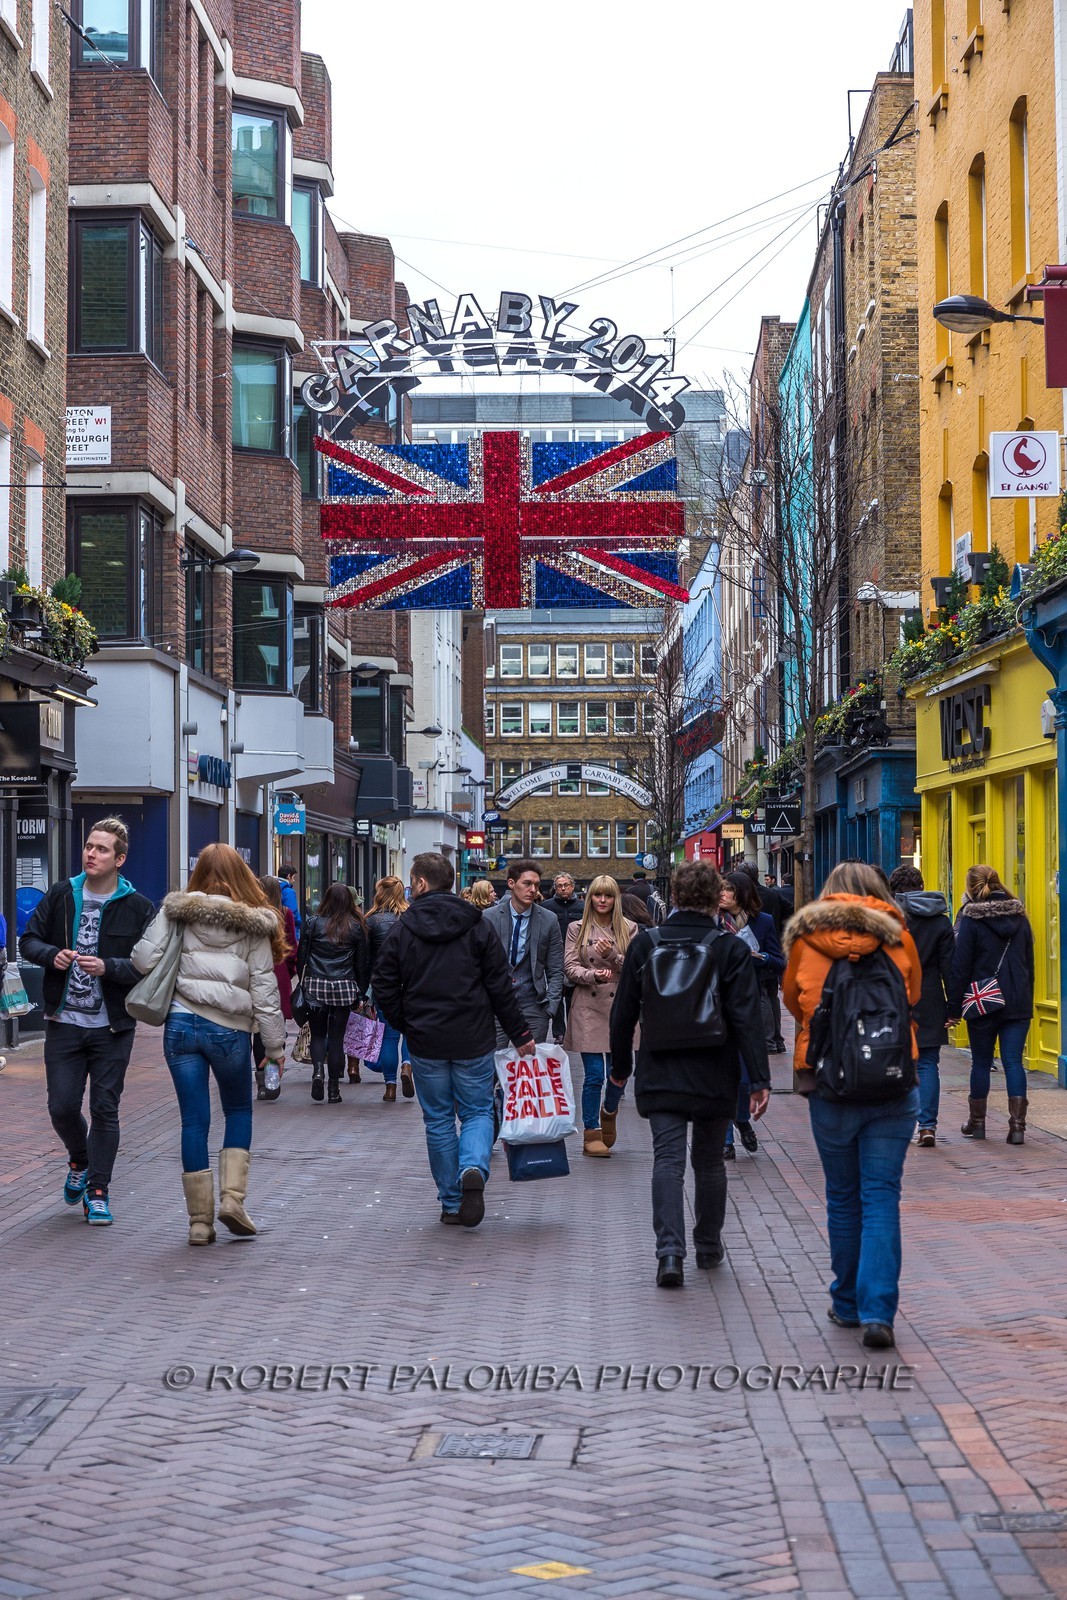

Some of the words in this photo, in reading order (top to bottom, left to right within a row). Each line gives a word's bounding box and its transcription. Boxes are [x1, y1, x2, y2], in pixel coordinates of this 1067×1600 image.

[301, 290, 580, 413] CARNABY
[578, 317, 692, 409] 2014
[504, 774, 543, 801] WELCOME
[549, 770, 561, 778] TO
[584, 769, 623, 785] CARNABY
[16, 819, 46, 834] TORM
[750, 823, 766, 833] VAN
[506, 1057, 562, 1082] SALE
[507, 1077, 565, 1101] SALE
[505, 1097, 570, 1121] SALE
